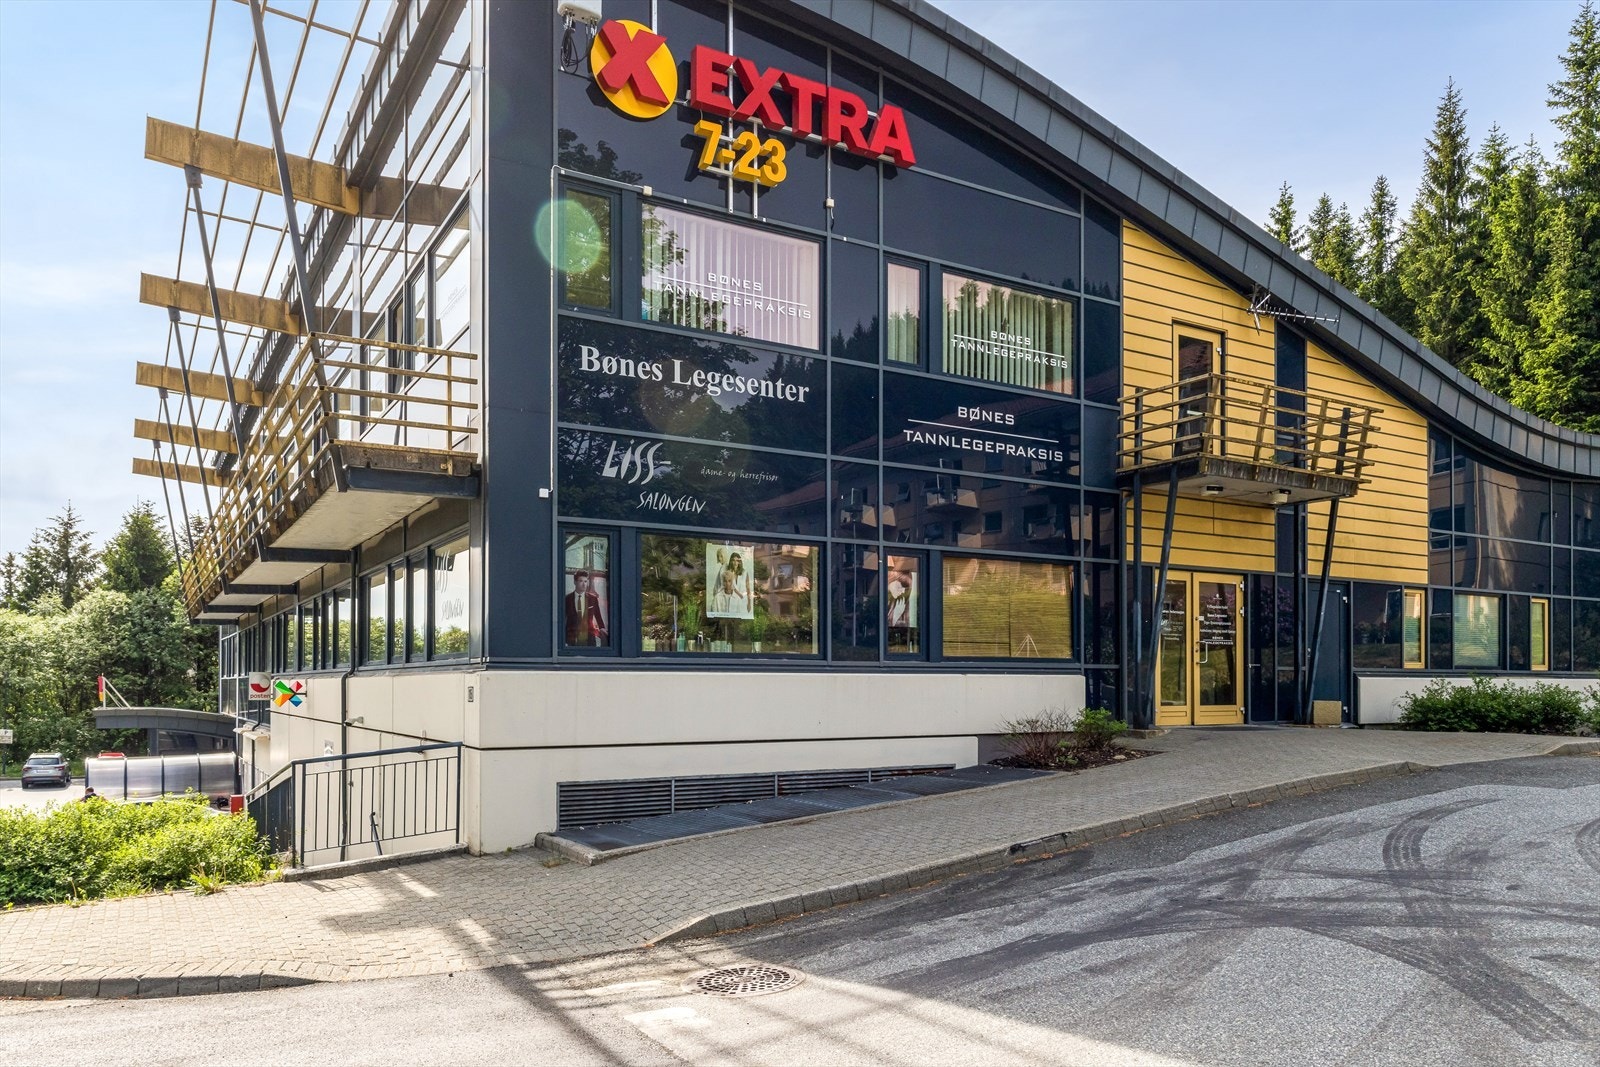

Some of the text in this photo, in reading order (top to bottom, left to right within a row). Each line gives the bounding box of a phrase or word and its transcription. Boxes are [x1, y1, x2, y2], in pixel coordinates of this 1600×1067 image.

[690, 44, 917, 169] EXTRA
[694, 119, 787, 187] 7-23
[707, 272, 763, 292] BØNES
[653, 280, 812, 319] TANNLEGEPRAKSIS
[990, 330, 1031, 346] BØNES
[951, 339, 1068, 369] TANNLEGEPRAKSIS
[578, 344, 810, 403] Bønes Legesenter
[957, 405, 1015, 426] BØNES
[903, 429, 1064, 462] TANNLEGEPRAKSIS
[728, 470, 736, 482] og
[740, 469, 779, 485] herrefrisør
[636, 490, 707, 515] SALONGEN
